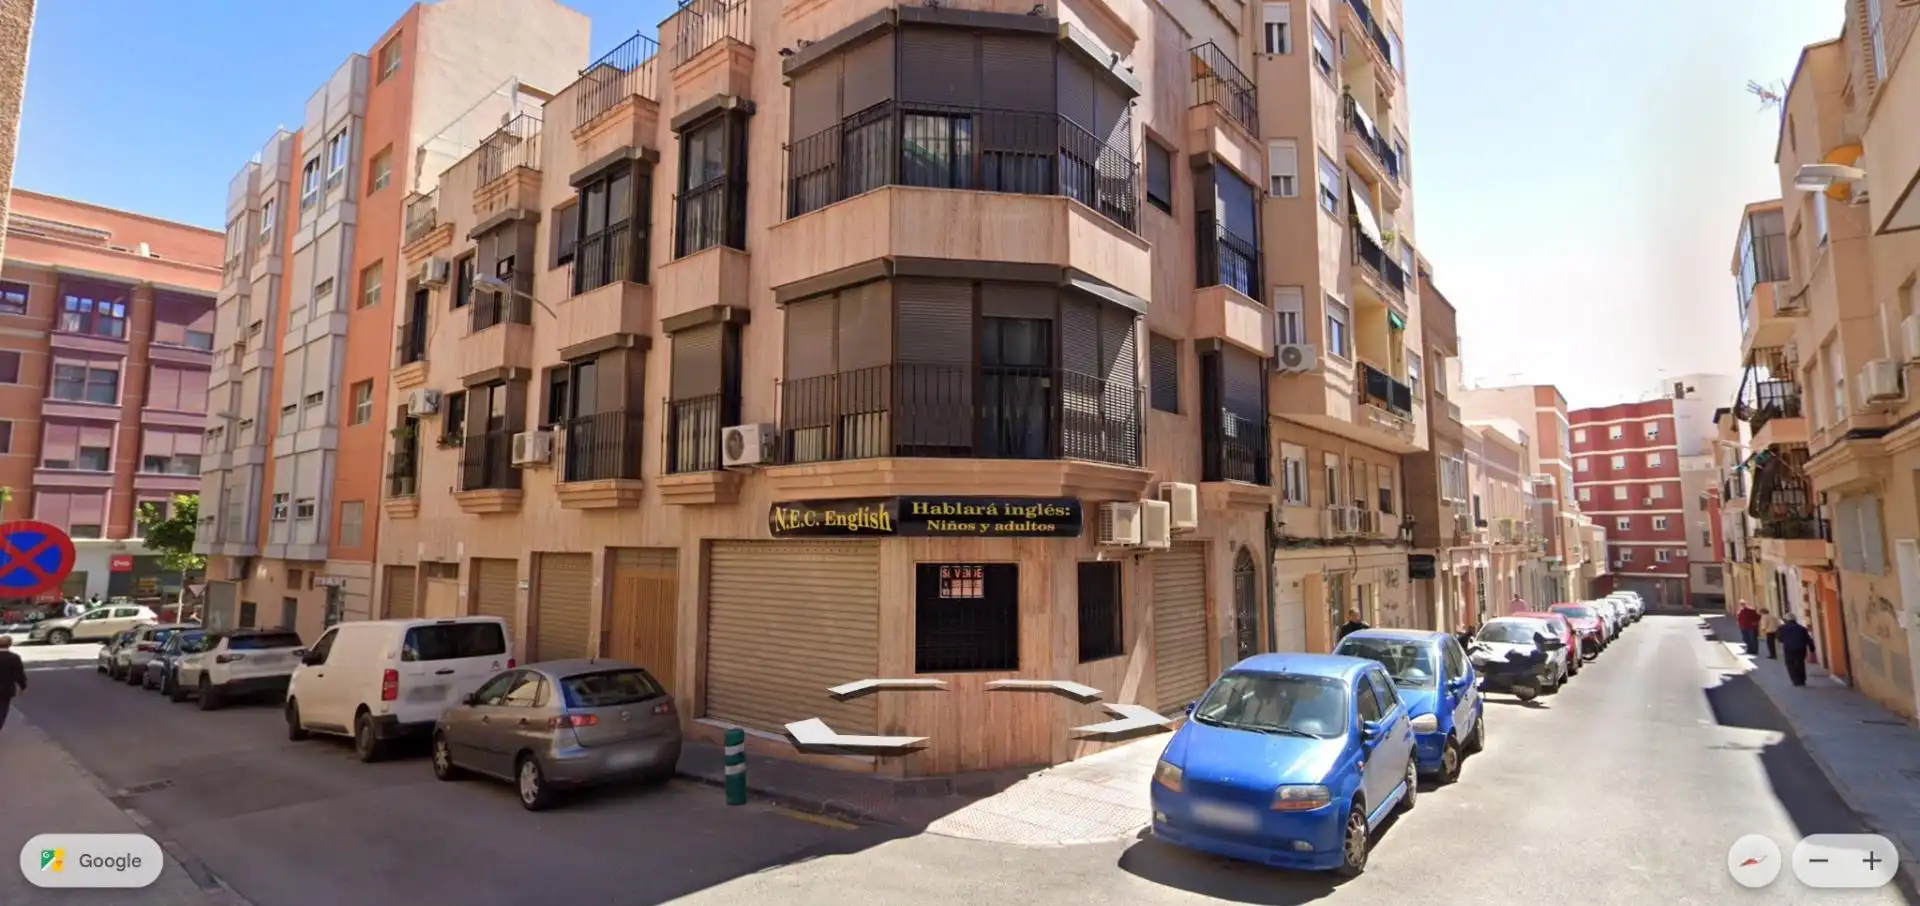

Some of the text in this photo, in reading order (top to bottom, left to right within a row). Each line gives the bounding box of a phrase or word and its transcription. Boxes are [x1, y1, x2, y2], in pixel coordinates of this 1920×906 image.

[775, 503, 893, 532] N.E.C. English
[911, 501, 1071, 519] Hablará inglés:
[927, 519, 1056, 533] Niños y adultos
